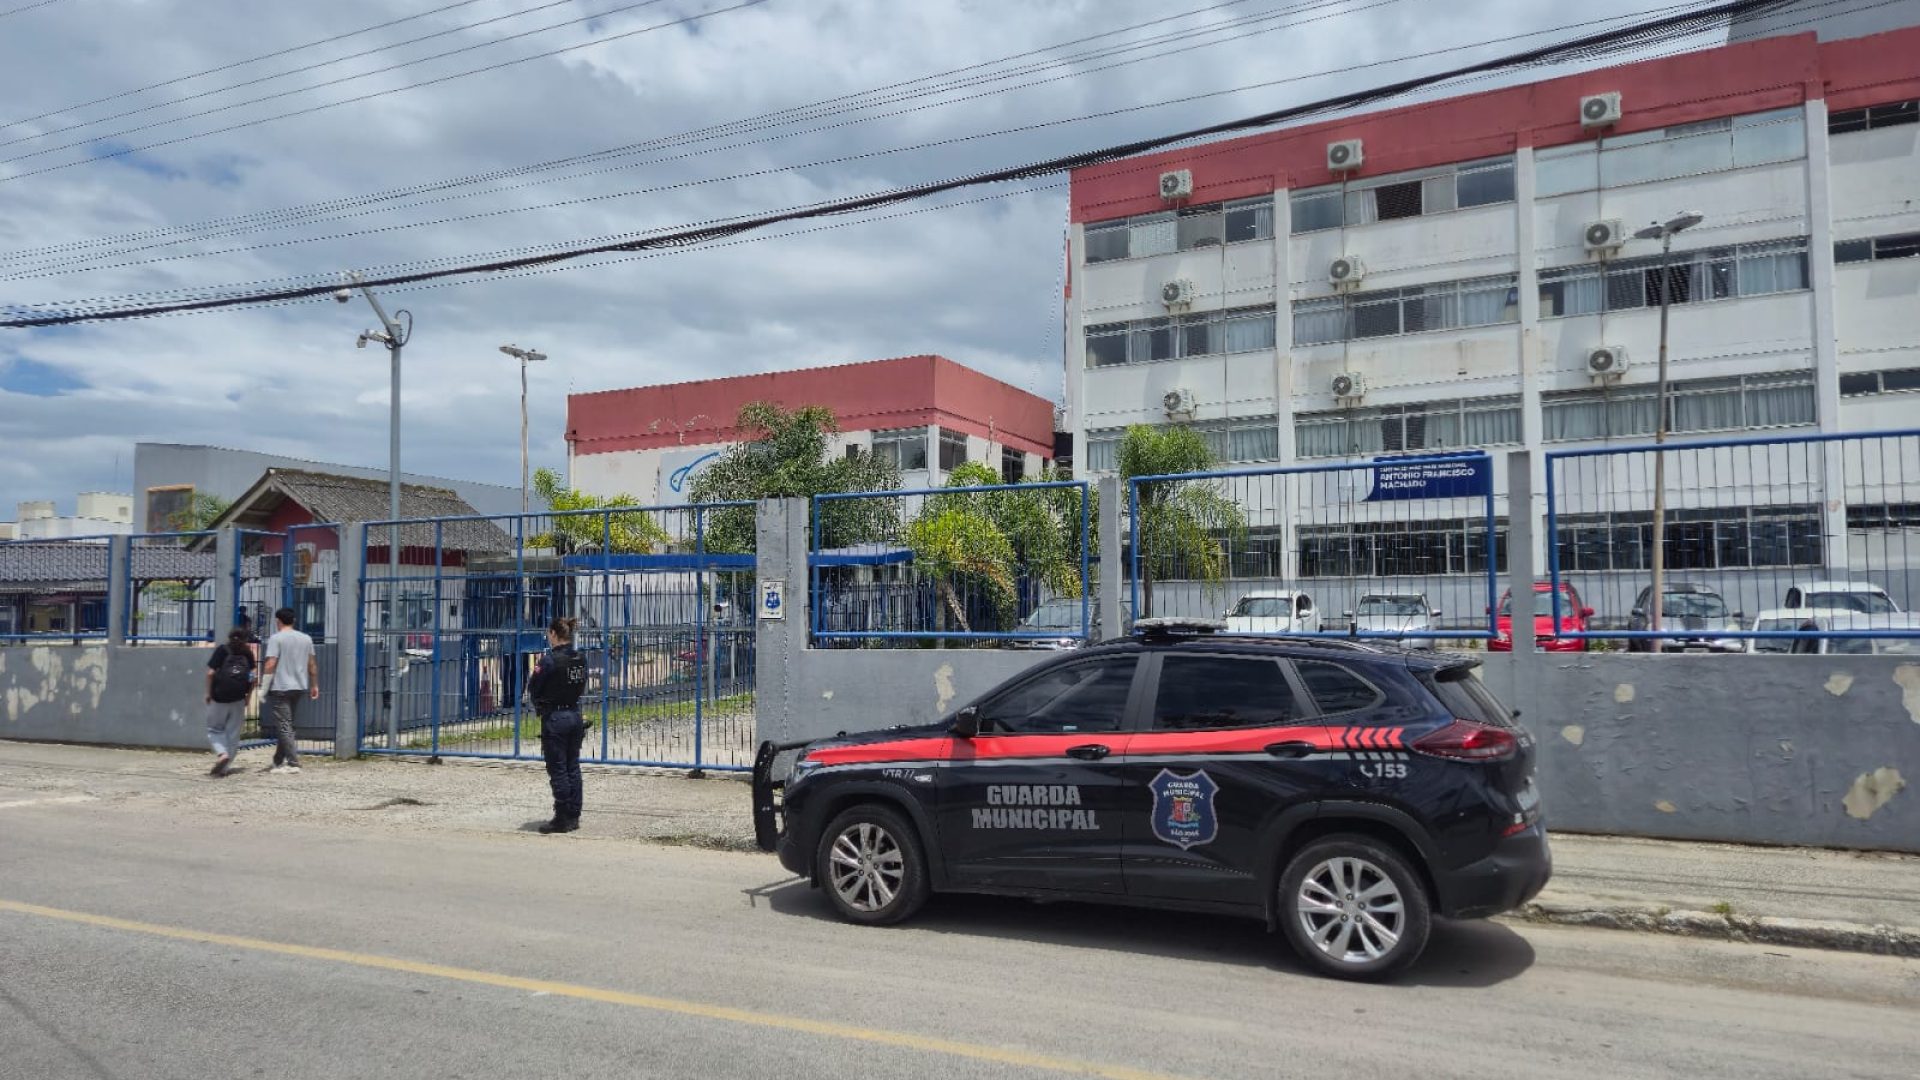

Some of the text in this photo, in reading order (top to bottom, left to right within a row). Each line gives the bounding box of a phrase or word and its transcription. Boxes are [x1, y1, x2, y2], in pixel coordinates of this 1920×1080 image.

[1422, 468, 1475, 478] FRANCISCO
[1380, 480, 1426, 489] MACHADO
[1374, 763, 1408, 778] 153
[986, 785, 1081, 805] GUARDA
[1163, 789, 1204, 799] MUNICIPAL
[971, 808, 1100, 830] MUNICIPAL
